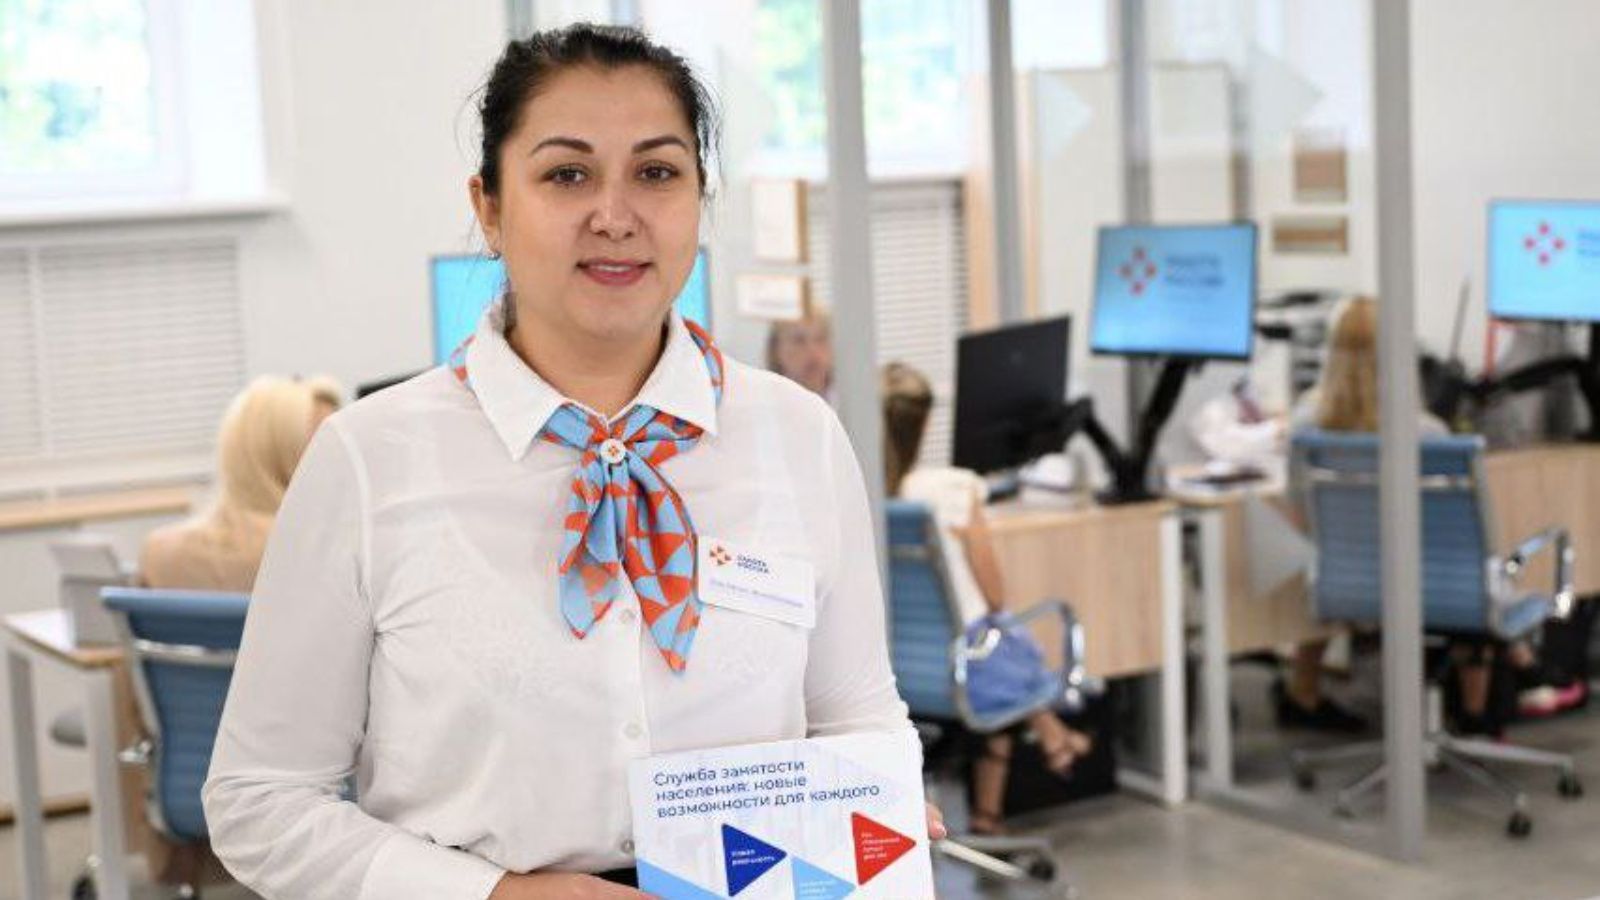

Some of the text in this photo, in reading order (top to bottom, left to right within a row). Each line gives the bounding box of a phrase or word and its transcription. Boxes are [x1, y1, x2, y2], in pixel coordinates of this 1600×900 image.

[651, 761, 805, 787] Служба занятости
[656, 776, 807, 802] населения: новые
[657, 785, 880, 818] возможности для каждого
